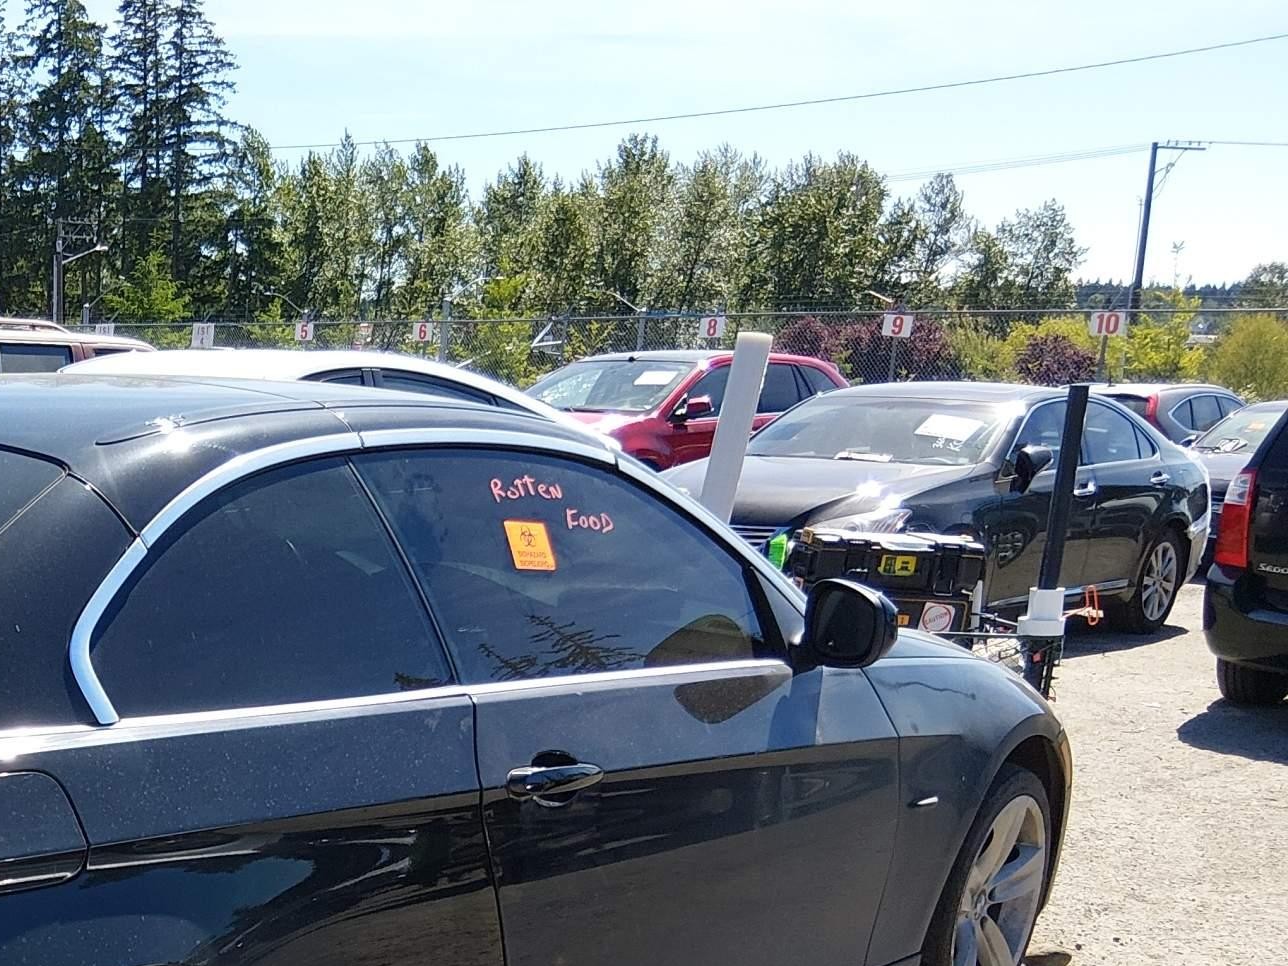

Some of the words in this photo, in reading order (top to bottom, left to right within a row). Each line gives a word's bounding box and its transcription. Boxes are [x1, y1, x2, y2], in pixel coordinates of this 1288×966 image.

[300, 323, 308, 339] 5
[418, 323, 427, 340] 6
[706, 318, 717, 337] 8
[891, 316, 904, 335] 9
[1097, 313, 1120, 335] 10
